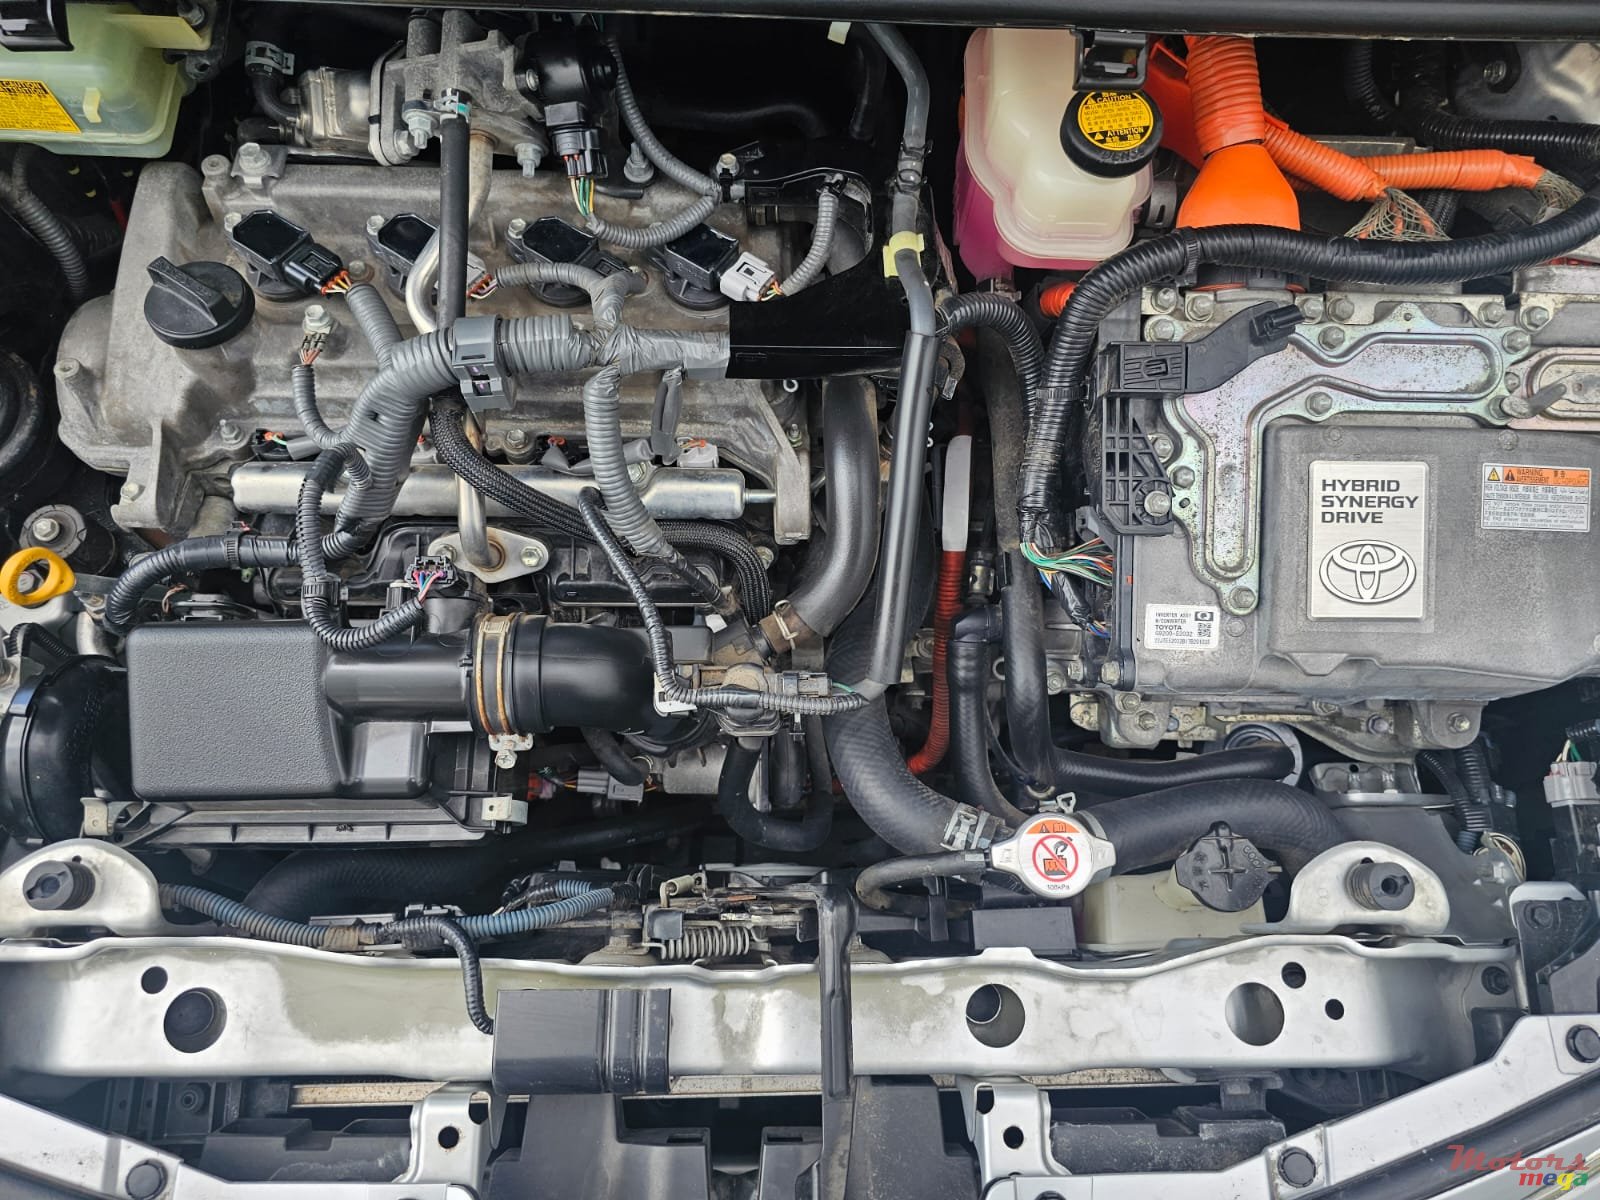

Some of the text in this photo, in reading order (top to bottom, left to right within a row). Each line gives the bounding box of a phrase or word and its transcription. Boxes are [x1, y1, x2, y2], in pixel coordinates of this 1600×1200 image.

[1096, 94, 1132, 103] CAUTION
[1107, 127, 1144, 137] ATTENTION
[1321, 479, 1401, 492] HYBRID
[1321, 495, 1419, 509] SYNERGY
[1321, 511, 1384, 524] DRIVE
